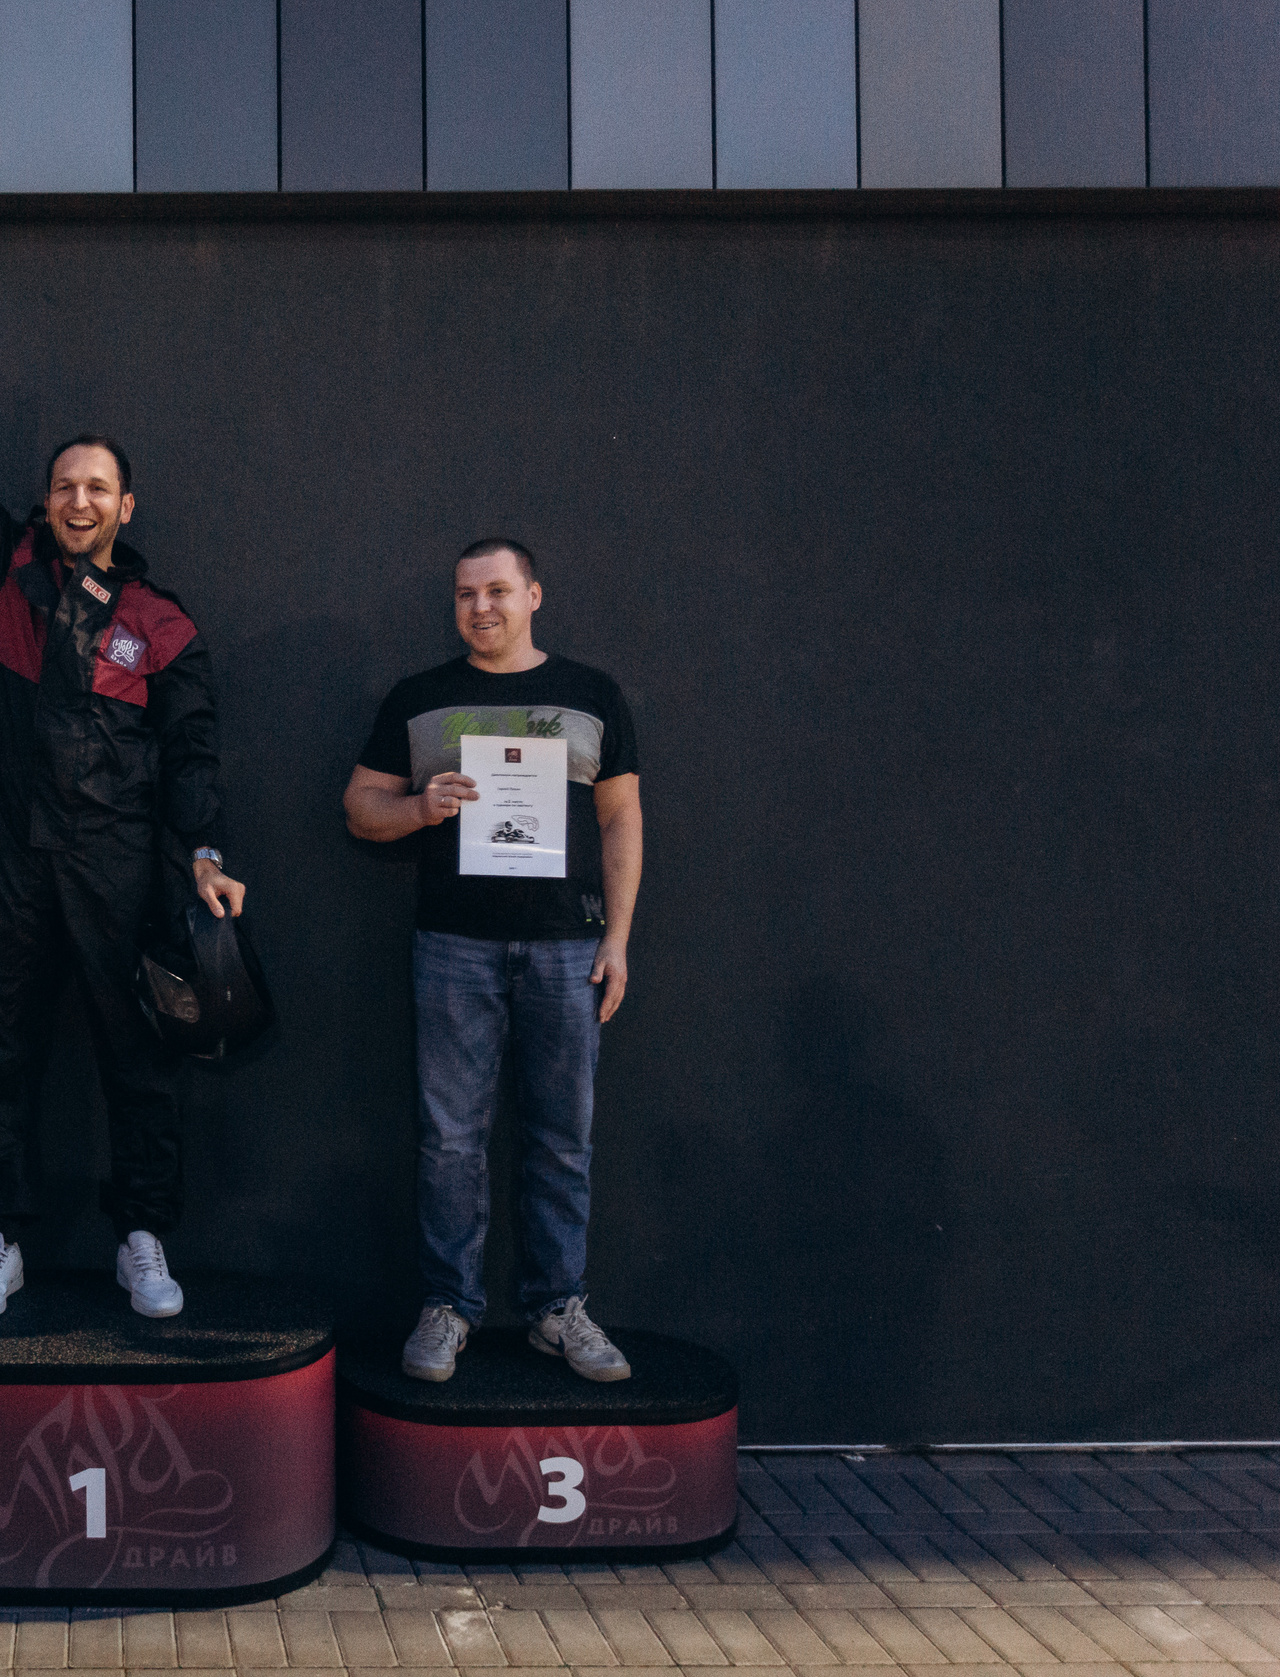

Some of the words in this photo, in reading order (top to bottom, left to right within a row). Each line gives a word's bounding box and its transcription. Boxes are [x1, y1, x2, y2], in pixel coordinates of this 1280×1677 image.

[85, 580, 108, 600] RLG
[68, 1467, 107, 1539] 1
[536, 1456, 587, 1524] 3
[588, 1512, 678, 1535] ДРАЙВ
[122, 1540, 238, 1569] ДРАЙВ
